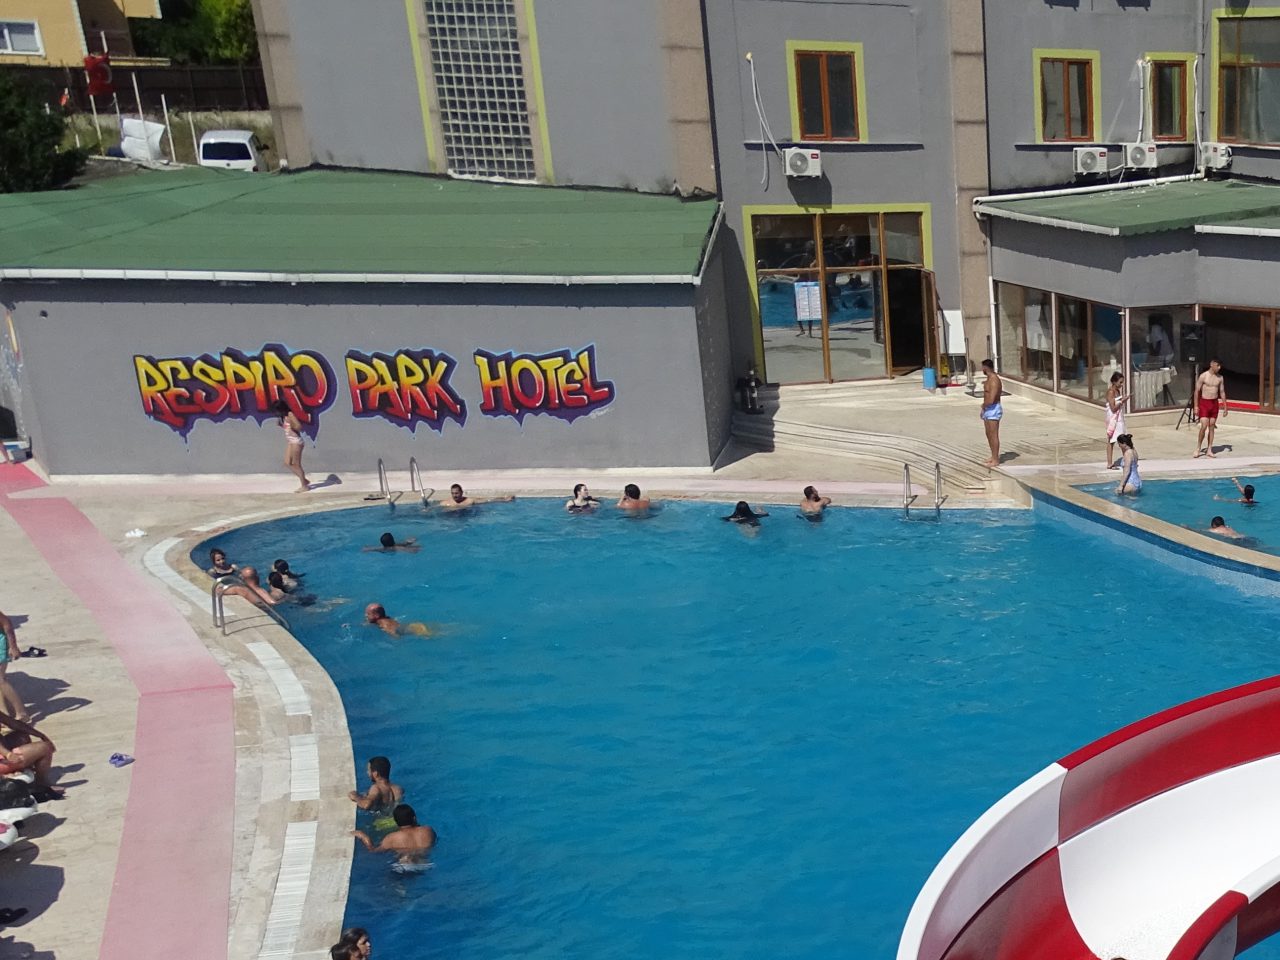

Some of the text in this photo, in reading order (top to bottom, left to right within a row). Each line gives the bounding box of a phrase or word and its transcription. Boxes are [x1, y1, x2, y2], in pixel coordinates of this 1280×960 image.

[134, 349, 610, 428] RESPIRO PARK HOTEL
